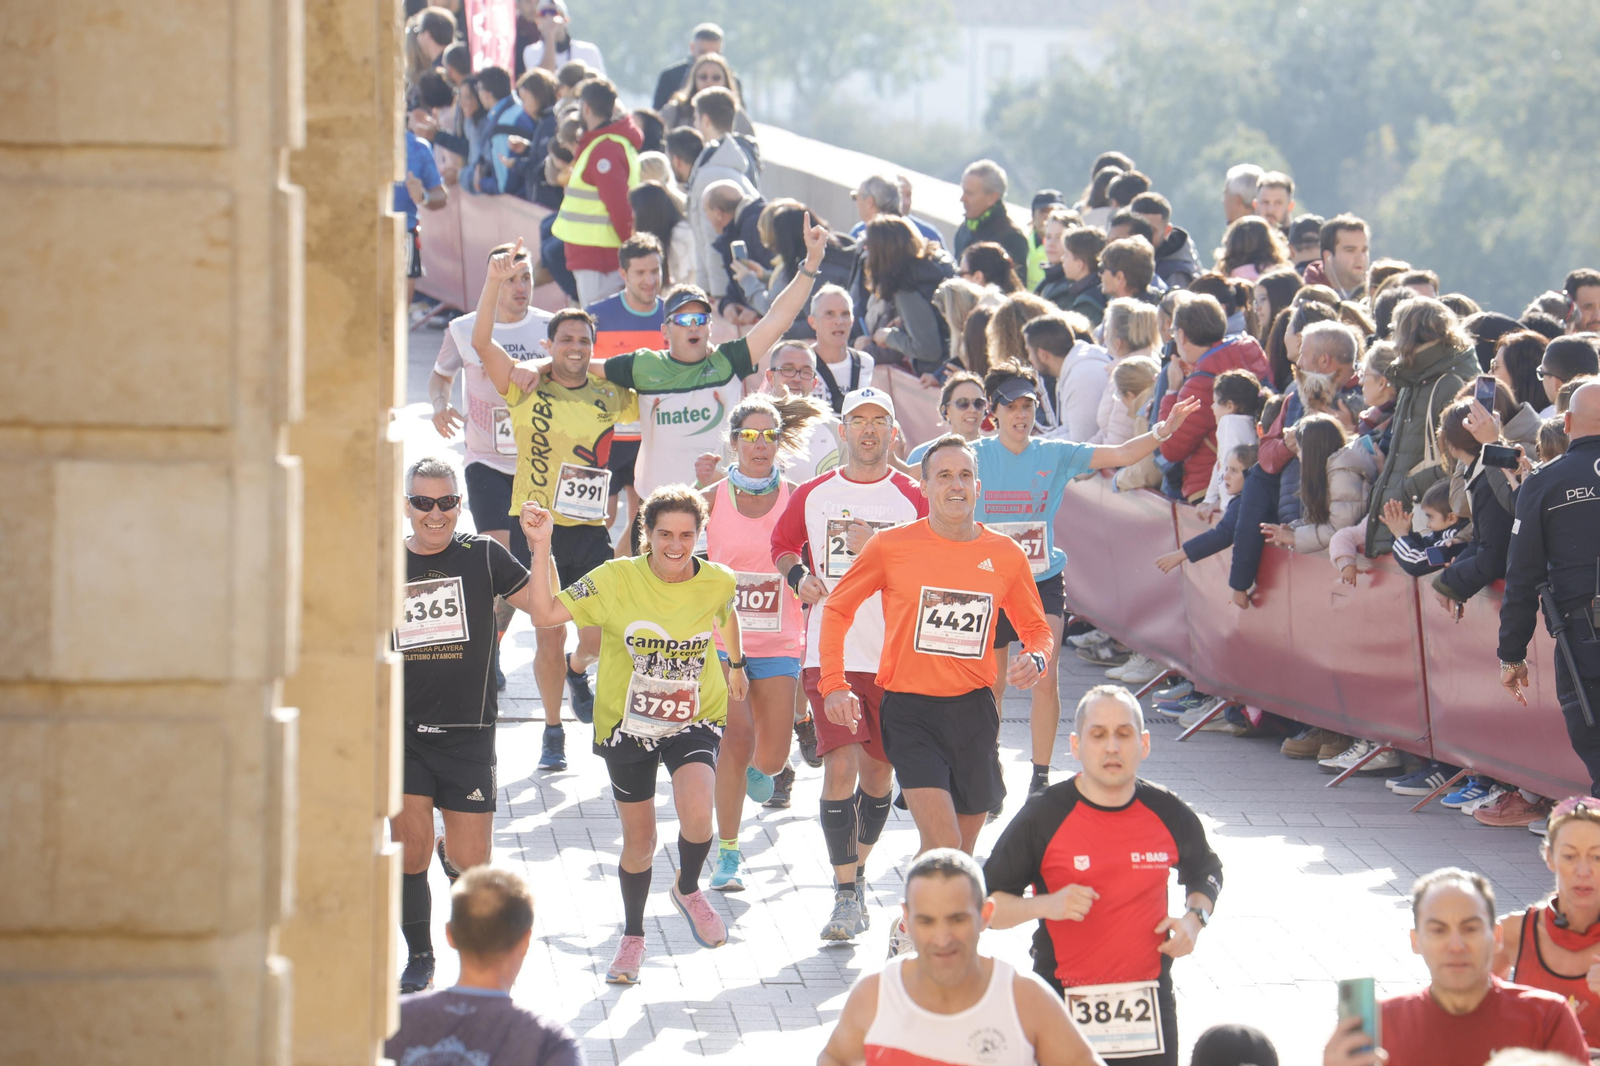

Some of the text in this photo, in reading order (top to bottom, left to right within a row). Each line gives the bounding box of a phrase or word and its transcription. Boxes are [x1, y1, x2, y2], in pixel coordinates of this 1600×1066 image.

[656, 406, 711, 425] inatec
[526, 390, 556, 488] CÓRDOBA
[564, 481, 602, 502] 3991
[926, 609, 983, 633] 4421
[404, 652, 463, 661] TLETISMO AYAMONTE
[434, 644, 463, 652] PLAYERA
[633, 693, 691, 719] 3795
[1076, 998, 1151, 1025] 3842
